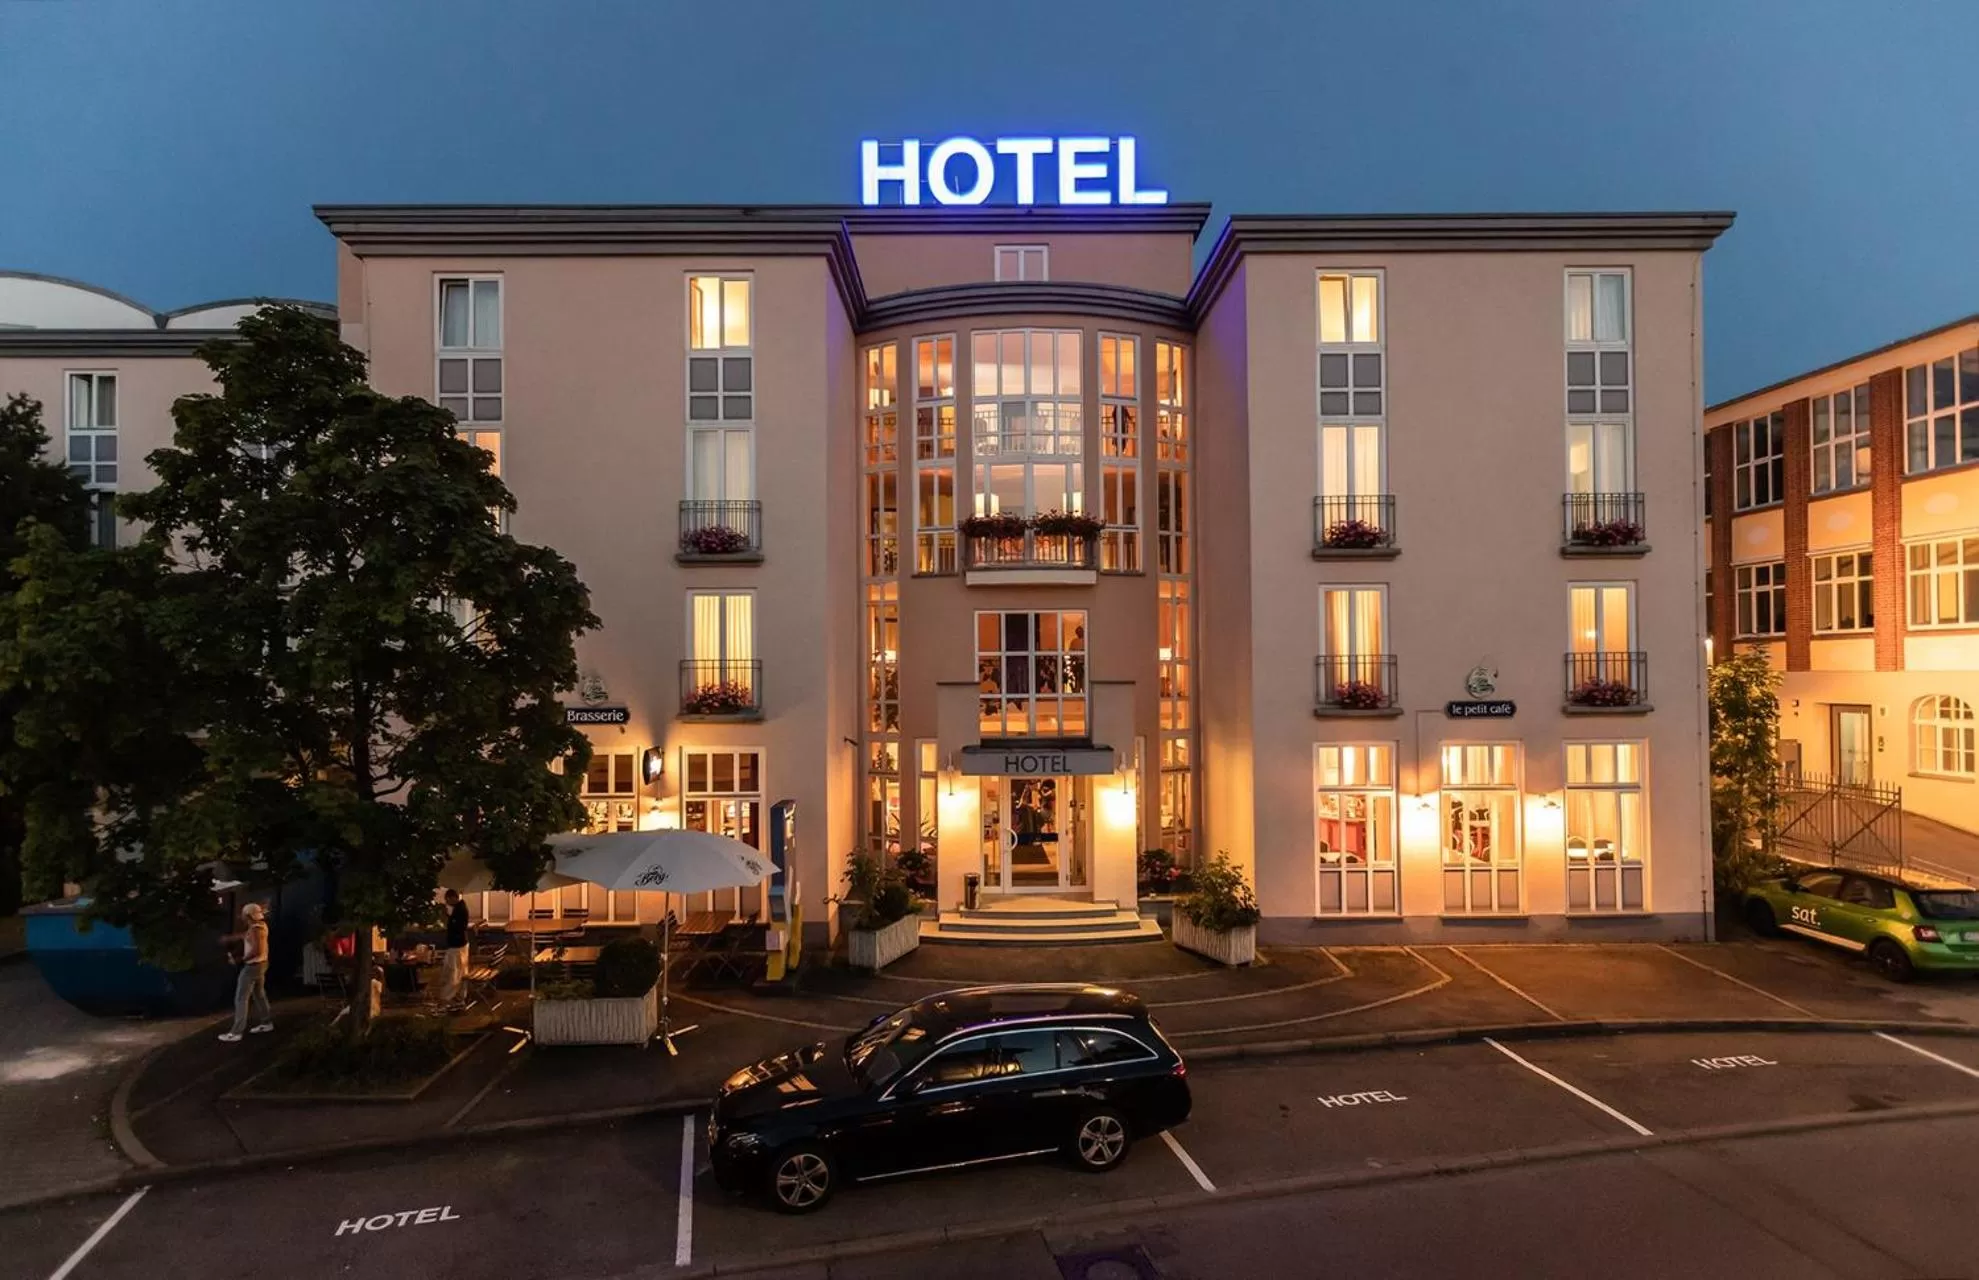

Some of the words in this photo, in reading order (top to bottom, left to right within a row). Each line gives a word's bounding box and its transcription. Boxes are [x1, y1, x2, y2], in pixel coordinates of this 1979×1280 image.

[862, 137, 1168, 205] HOTEL
[567, 709, 625, 722] Brasserie
[1452, 704, 1462, 715] le
[1464, 704, 1487, 716] petit
[1490, 704, 1512, 715] café
[1004, 755, 1071, 773] HOTEL
[1690, 1054, 1778, 1070] HOTEL
[1317, 1090, 1408, 1108] HOTEL
[334, 1205, 460, 1236] HOTEL
